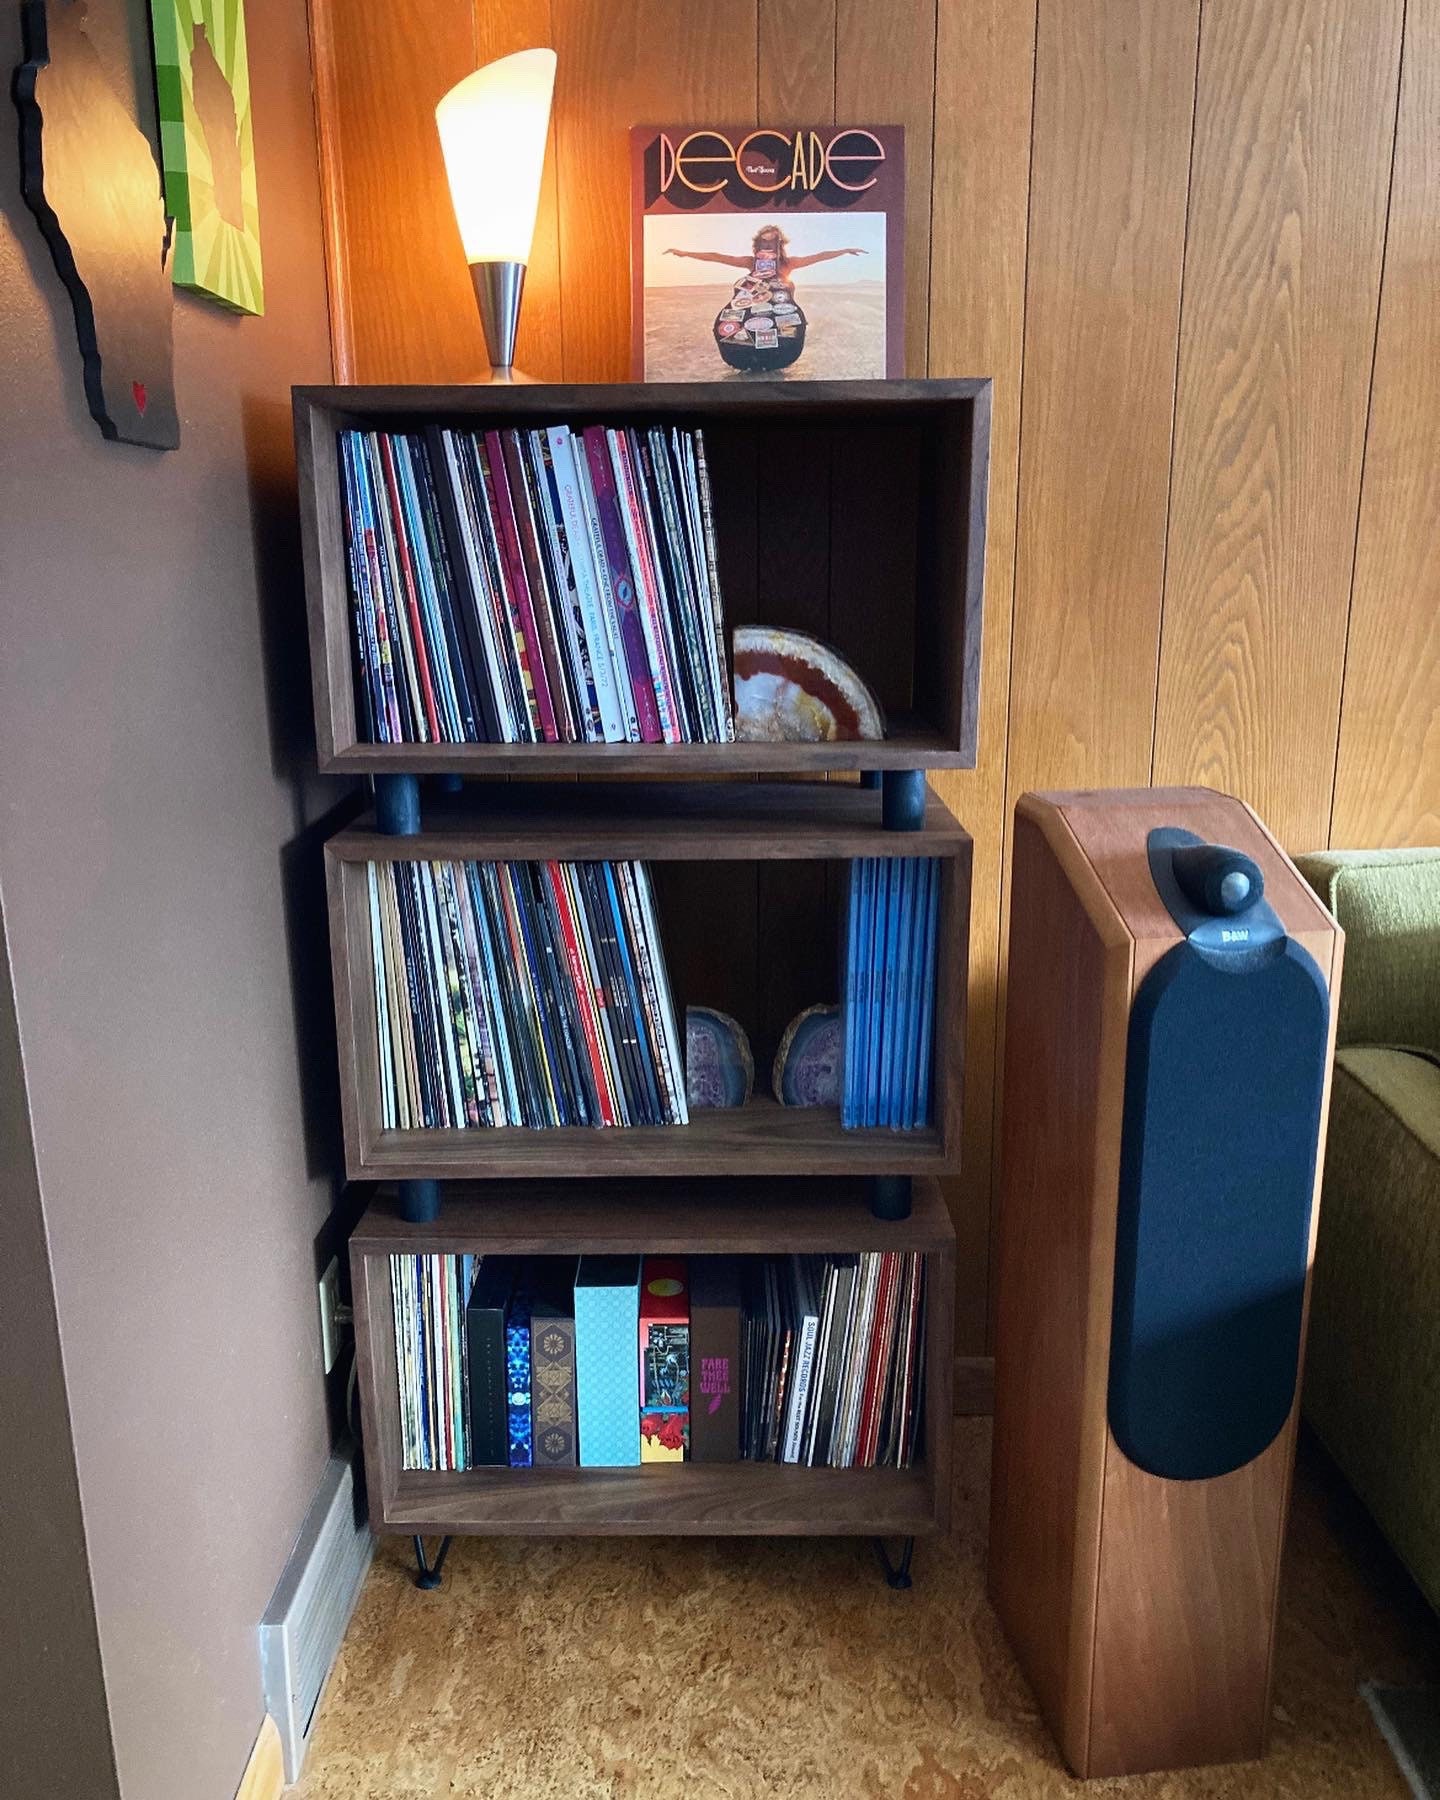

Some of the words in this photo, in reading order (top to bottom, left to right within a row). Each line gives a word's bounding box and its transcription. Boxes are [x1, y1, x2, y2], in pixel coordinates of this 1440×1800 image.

[1221, 929, 1249, 943] B&W
[805, 1321, 815, 1340] SOUL
[802, 1341, 812, 1359] JAZZ
[701, 1358, 729, 1369] FARE
[701, 1370, 729, 1382] THEE
[797, 1360, 809, 1392] RECORDS
[700, 1382, 731, 1393] WELL
